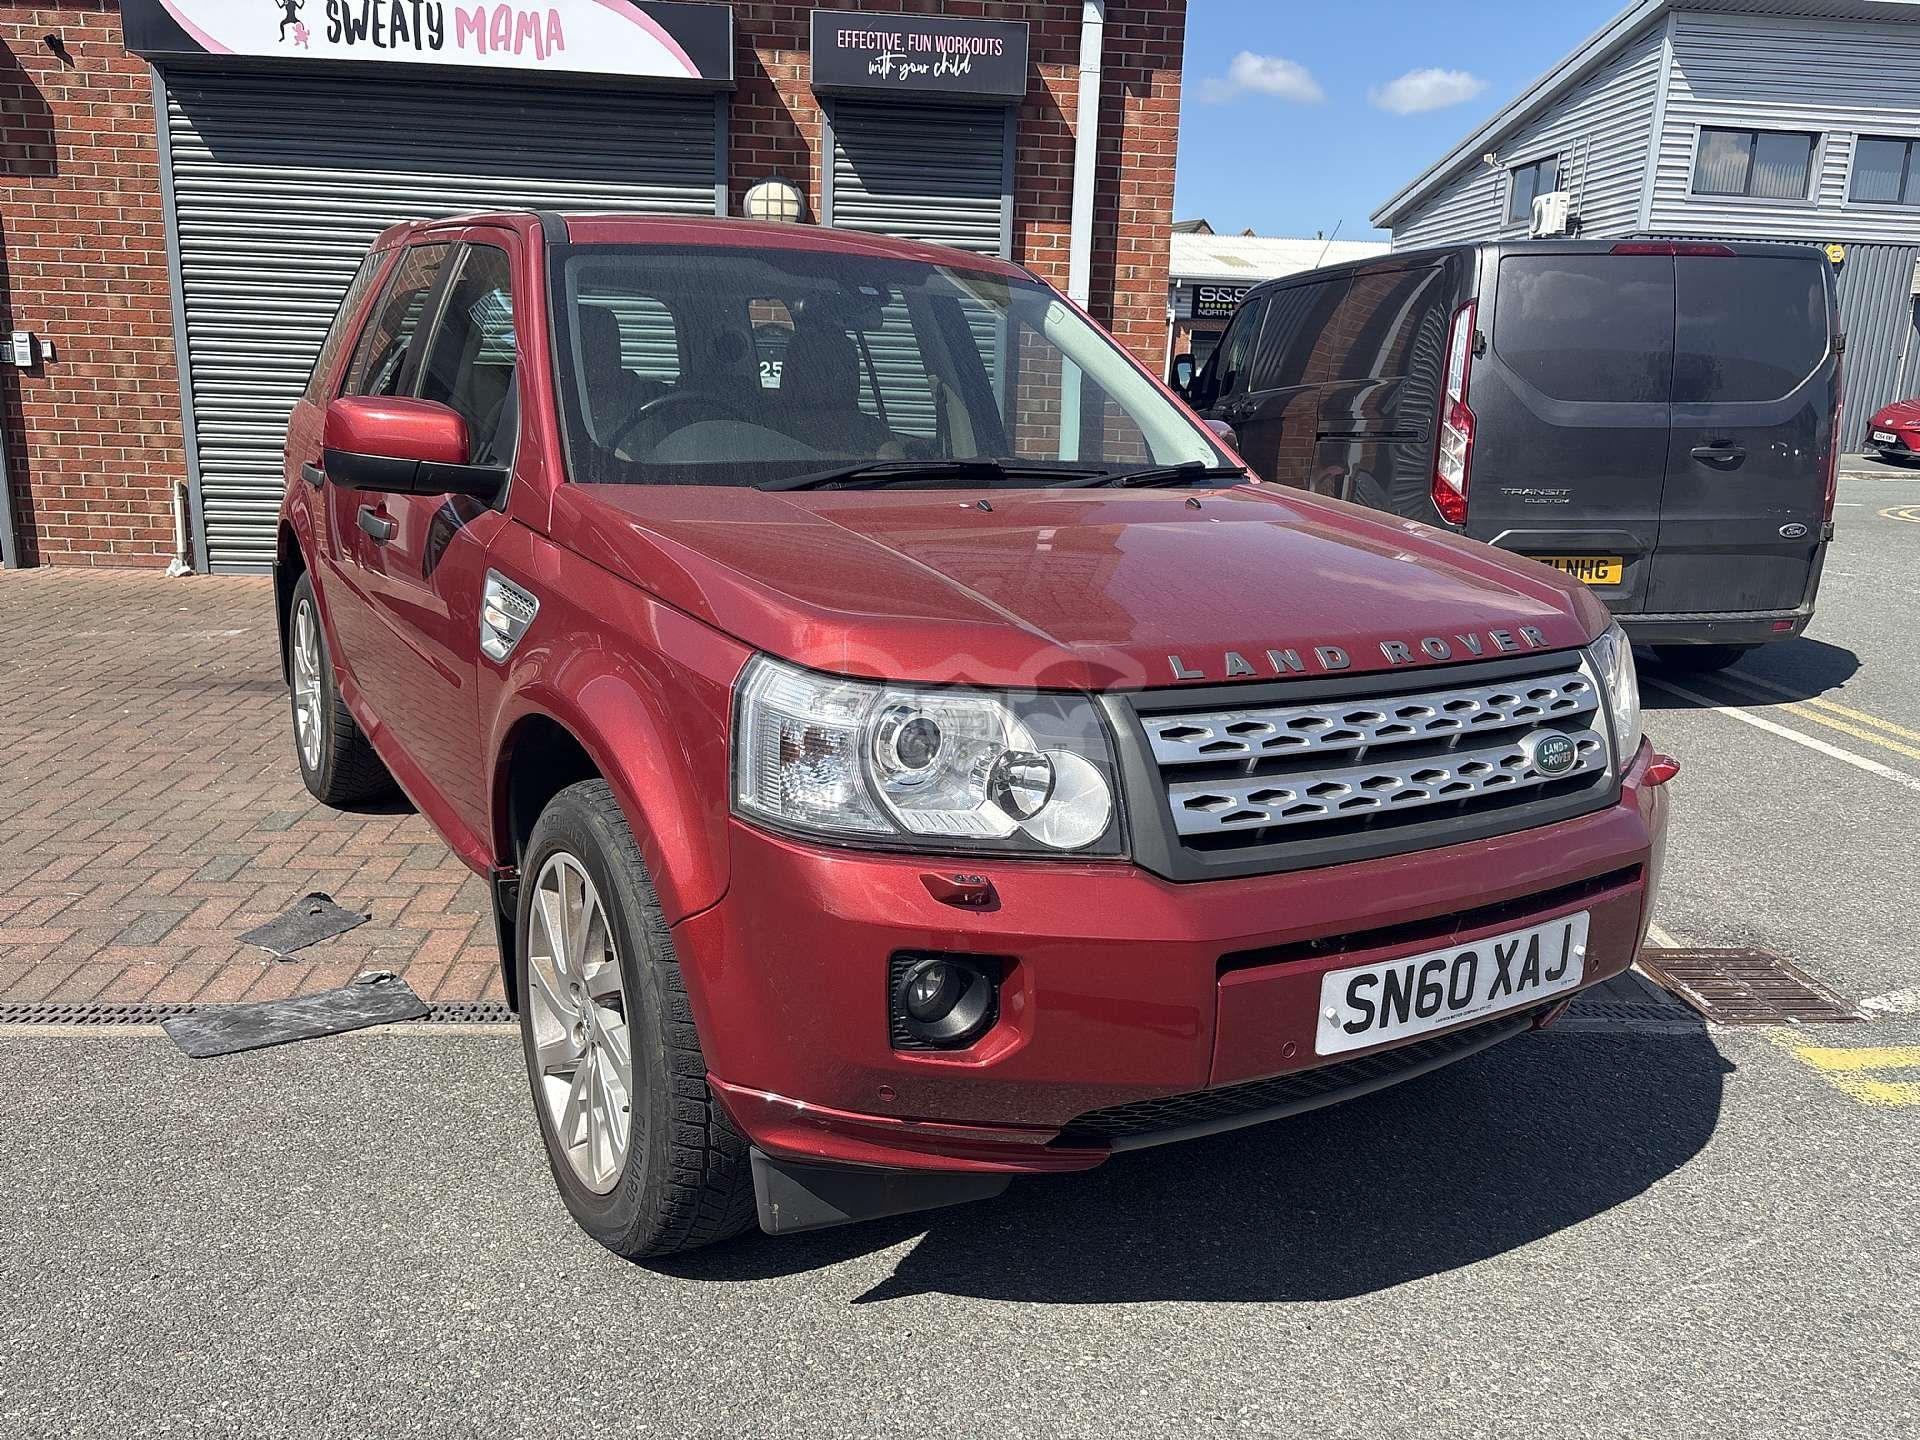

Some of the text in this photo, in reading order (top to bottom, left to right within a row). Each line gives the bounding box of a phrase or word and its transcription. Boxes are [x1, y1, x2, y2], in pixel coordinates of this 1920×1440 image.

[326, 0, 565, 60] SWEATY MAMA
[837, 29, 1003, 56] EFFECTIVE, FUN WORKOUTS
[868, 50, 972, 80] with your child
[759, 360, 784, 377] 25
[1500, 487, 1572, 496] TRANSIT
[1168, 625, 1550, 680] LAND ROVER
[1543, 741, 1564, 755] LAND
[1548, 751, 1573, 766] ROVER
[1342, 923, 1572, 1035] SN60 XAJ
